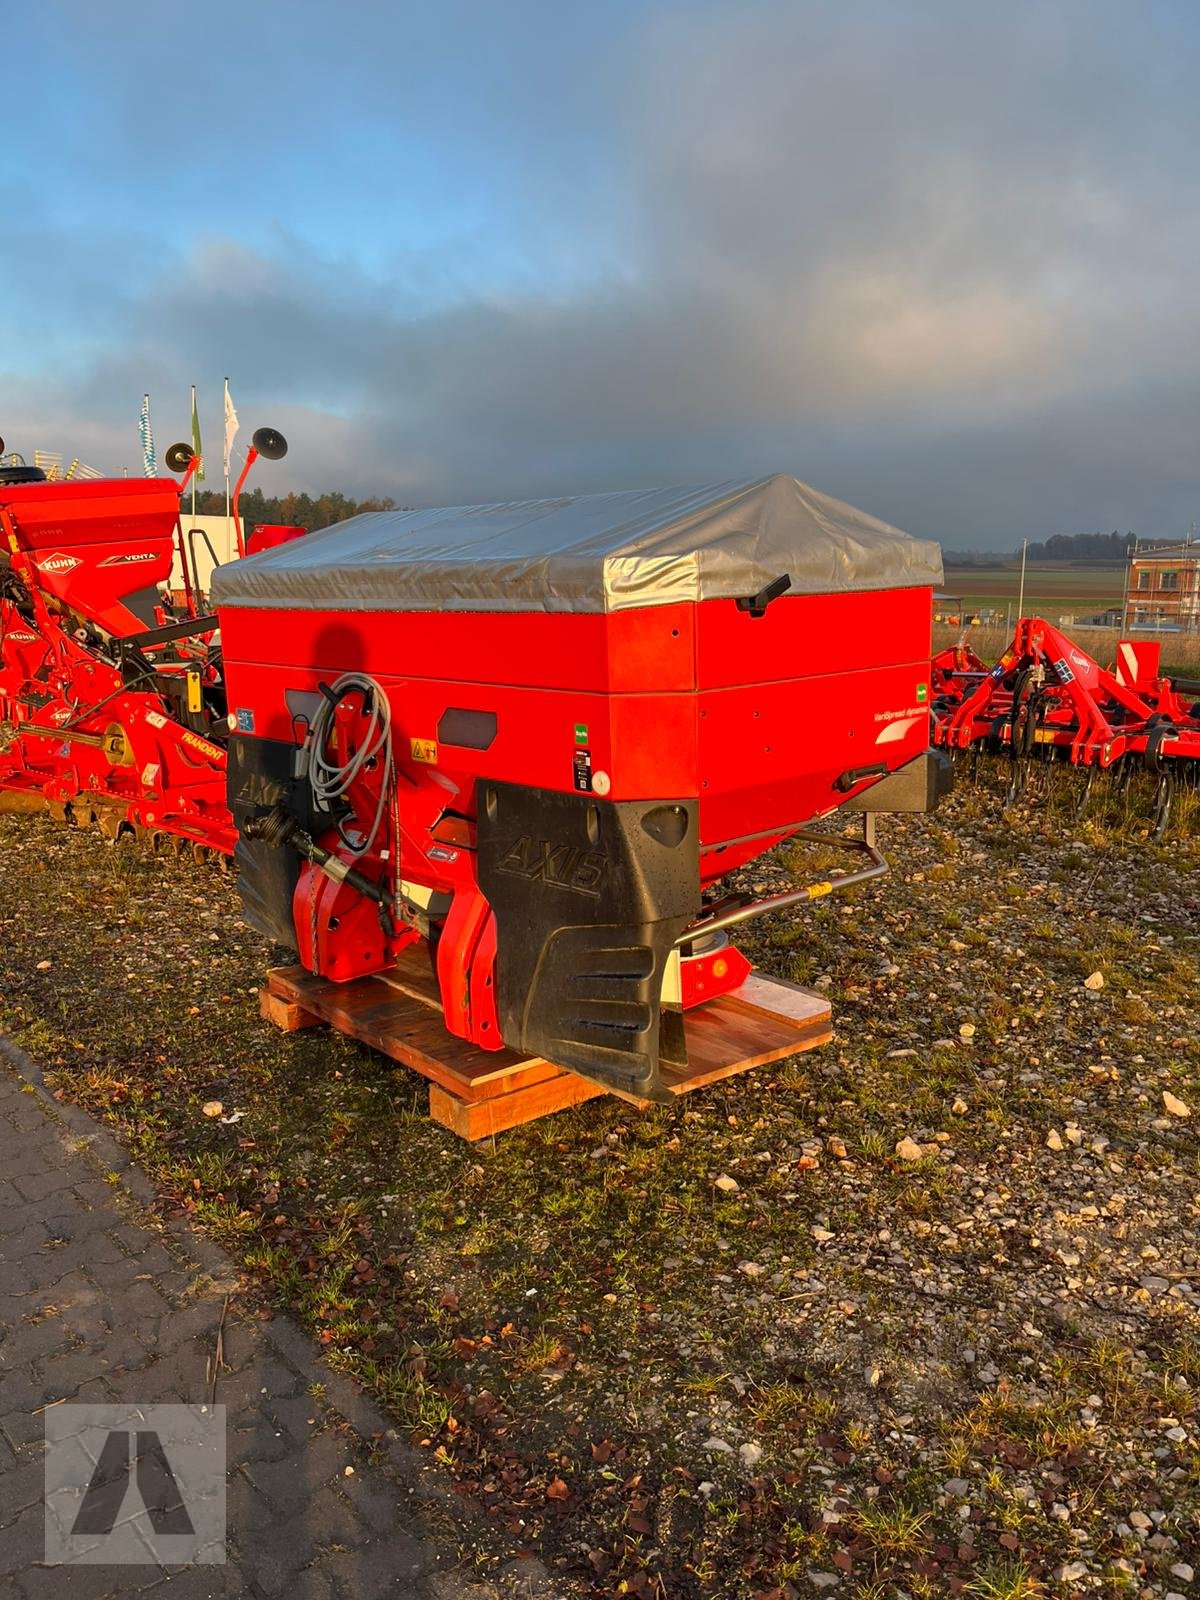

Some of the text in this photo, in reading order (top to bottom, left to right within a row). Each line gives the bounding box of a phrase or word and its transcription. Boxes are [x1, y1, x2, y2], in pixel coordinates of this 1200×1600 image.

[44, 557, 77, 571] KUHN
[124, 552, 156, 561] VENTA
[181, 731, 225, 761] FRANDENT
[496, 834, 608, 893] AXIS
